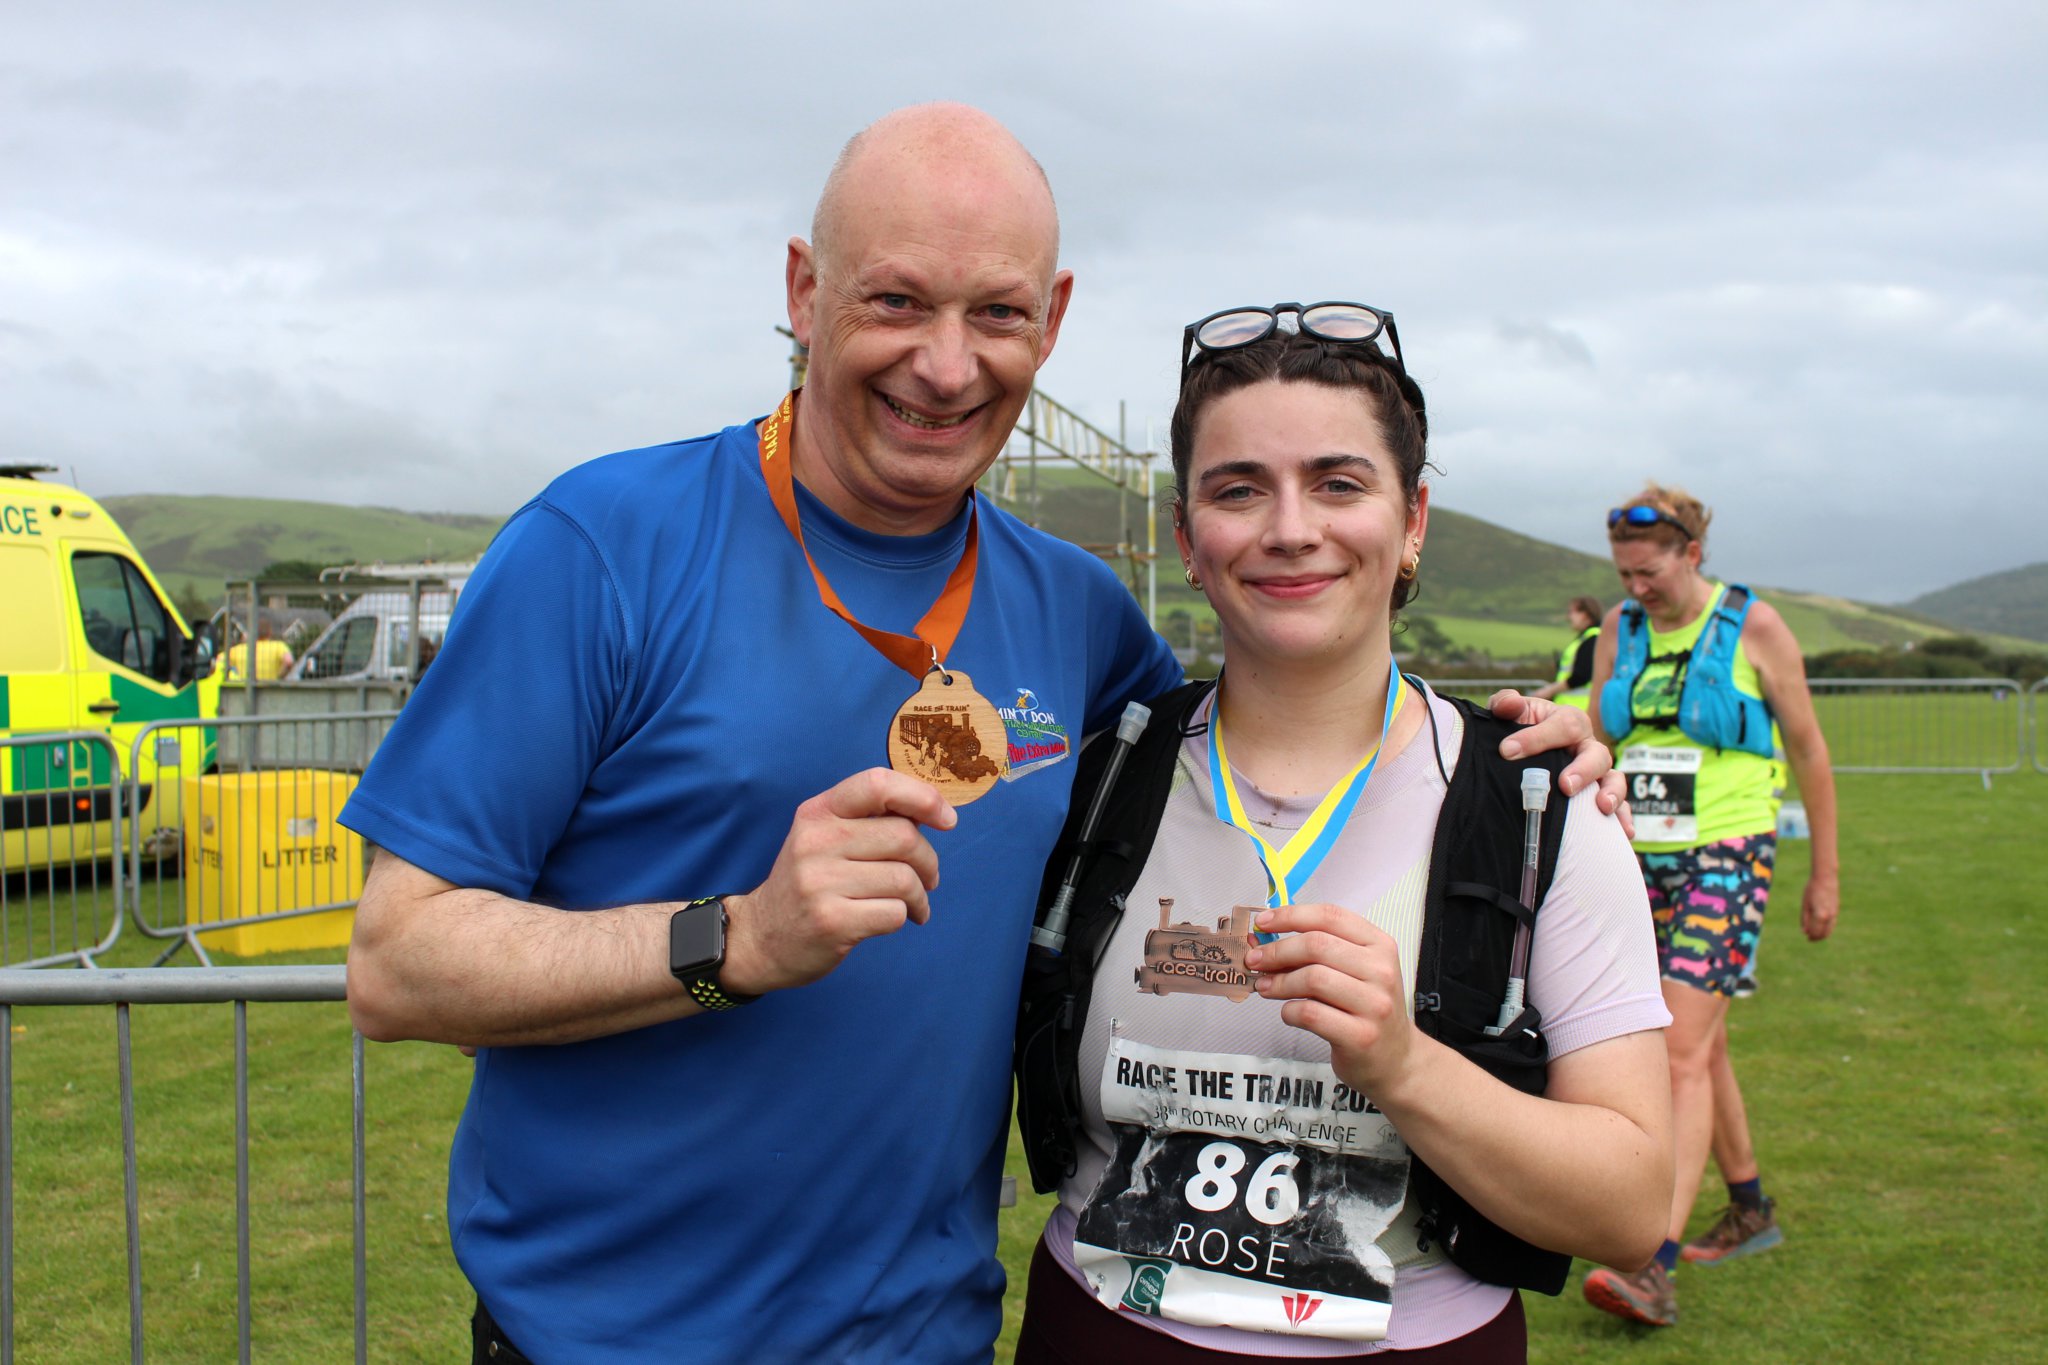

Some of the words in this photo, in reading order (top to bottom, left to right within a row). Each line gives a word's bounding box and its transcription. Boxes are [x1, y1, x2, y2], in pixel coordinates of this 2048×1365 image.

[763, 422, 778, 461] RACE
[0, 505, 42, 536] CE
[1019, 709, 1028, 721] Y
[1030, 710, 1056, 725] DON
[1008, 743, 1026, 762] The
[1026, 741, 1049, 759] Extra
[1633, 774, 1668, 800] 64
[262, 844, 338, 869] LITTER
[1156, 960, 1198, 976] race
[1204, 964, 1247, 986] train
[1116, 1056, 1177, 1094] RACE
[1185, 1068, 1234, 1101] THE
[1243, 1072, 1324, 1109] TRAIN
[1181, 1106, 1249, 1132] ROTARY
[1253, 1117, 1358, 1144] CHALLENGE
[1184, 1141, 1301, 1226] 86
[1168, 1222, 1291, 1279] ROSE
